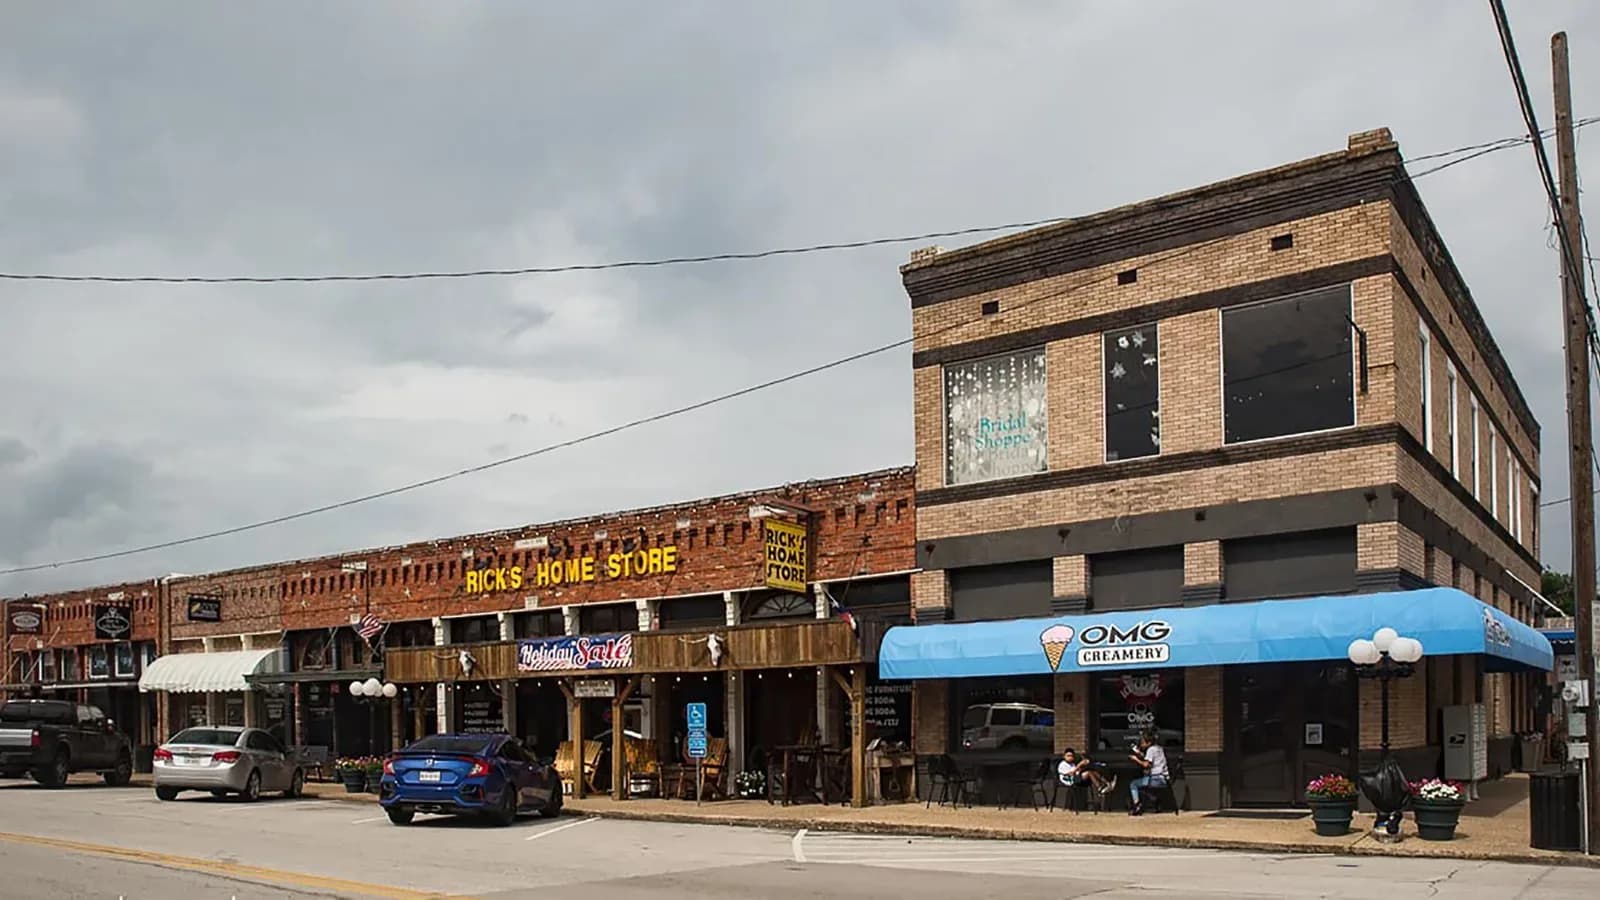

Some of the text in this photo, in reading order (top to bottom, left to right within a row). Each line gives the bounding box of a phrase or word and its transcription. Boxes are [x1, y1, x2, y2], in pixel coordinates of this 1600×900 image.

[979, 411, 1026, 433] Bridal
[974, 433, 1031, 449] Shoppe
[765, 528, 807, 550] RICK'S
[767, 545, 805, 566] HOME
[466, 546, 677, 593] RICK'S HOME STORE
[767, 563, 805, 583] STORE
[1079, 621, 1171, 645] OMG
[520, 635, 631, 668] Holiday Sale
[1082, 647, 1164, 662] CREAMERY
[1127, 712, 1155, 723] OMG
